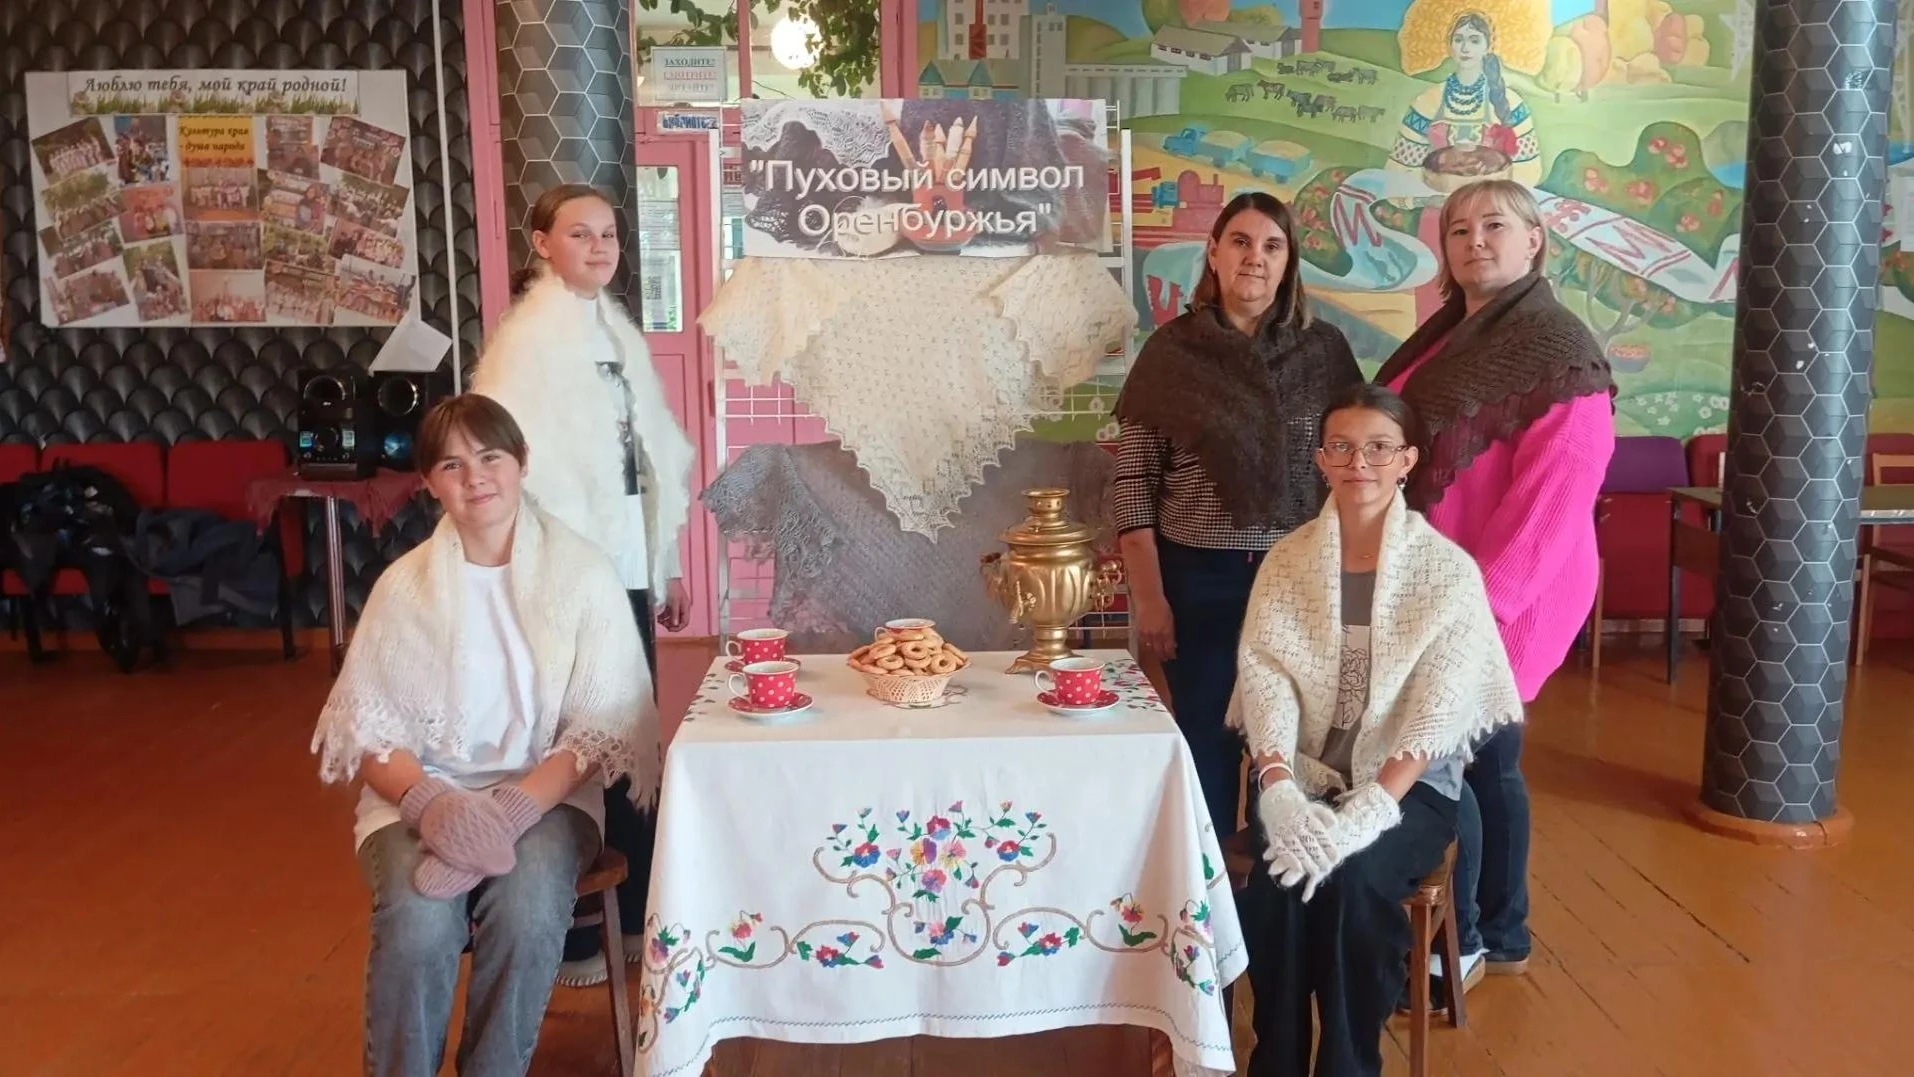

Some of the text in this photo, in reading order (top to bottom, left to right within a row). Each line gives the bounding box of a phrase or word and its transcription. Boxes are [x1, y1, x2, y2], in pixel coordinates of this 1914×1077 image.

[84, 74, 347, 96] Люблю тебя, мой край родной!
[749, 159, 1085, 200] "Пуховый символ
[799, 203, 1052, 239] Оренбуржья"
